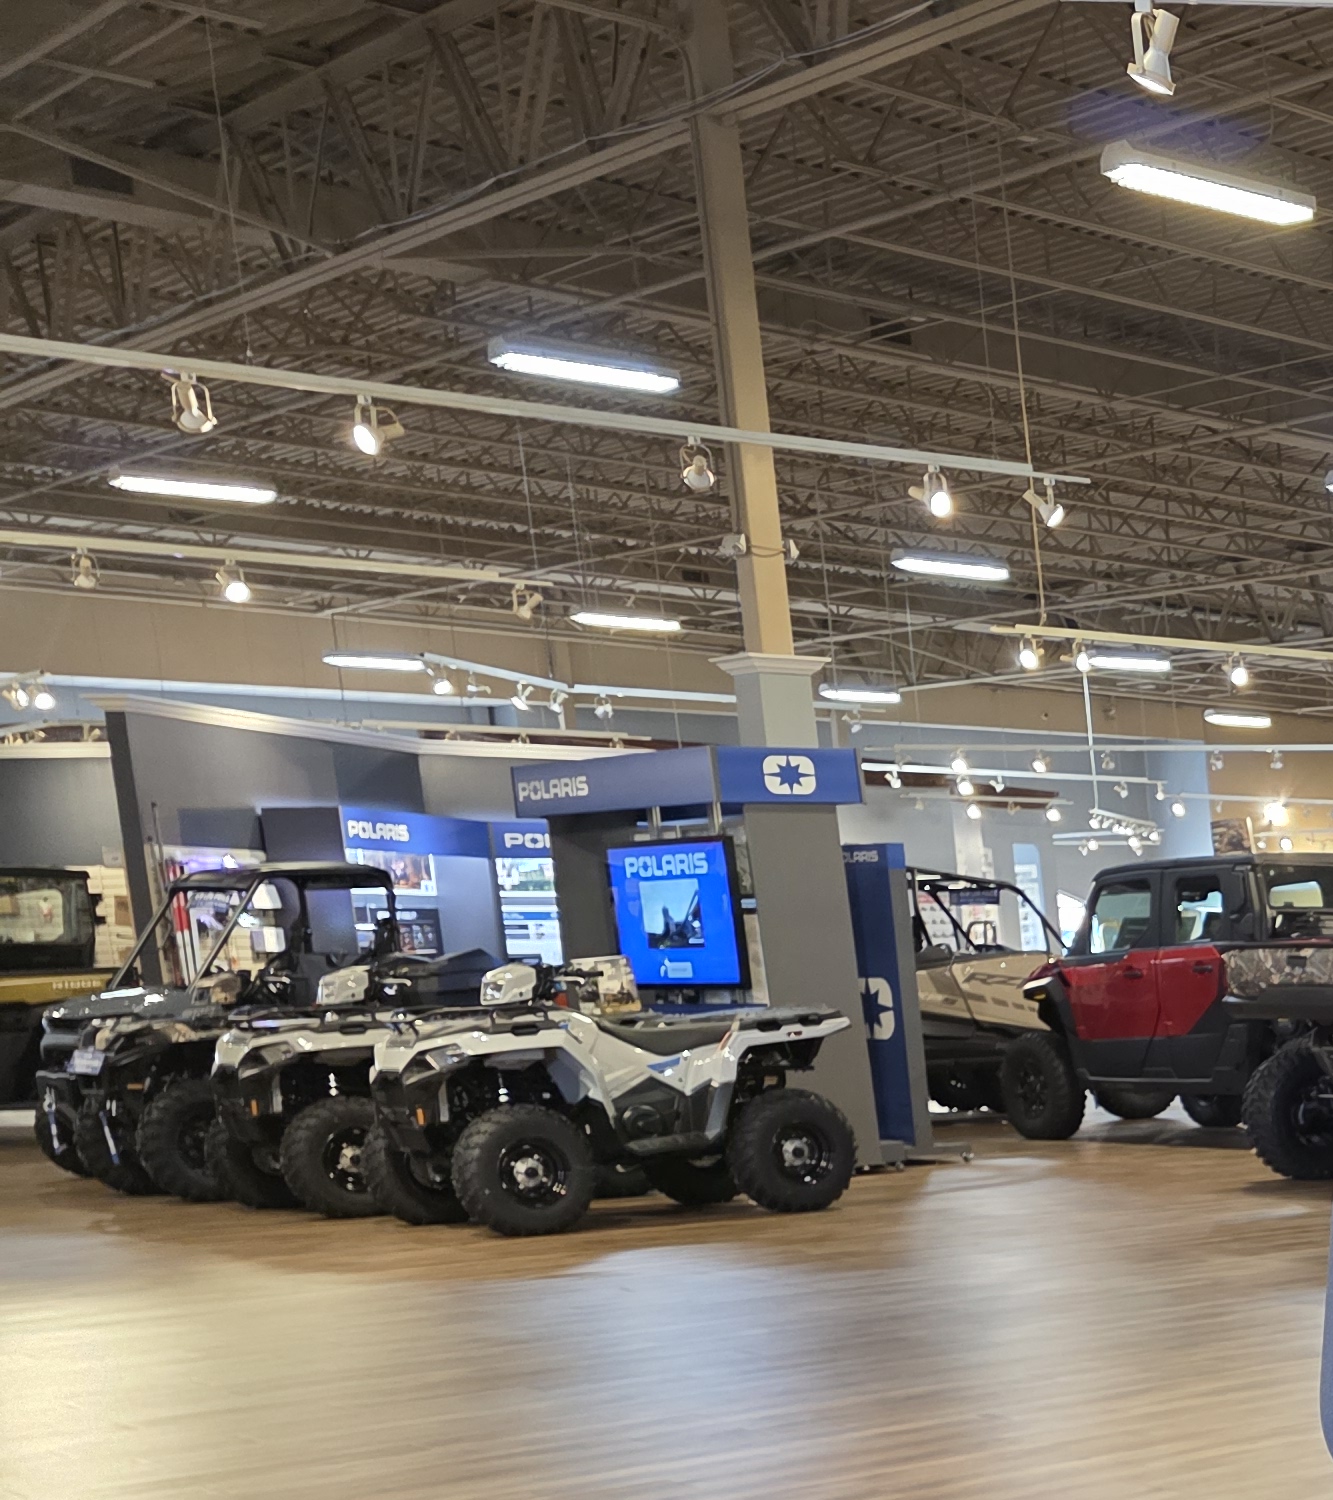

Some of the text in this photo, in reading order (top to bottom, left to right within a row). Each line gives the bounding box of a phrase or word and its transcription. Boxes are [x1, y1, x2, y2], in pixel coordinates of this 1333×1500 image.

[518, 776, 589, 802] POLARIS
[347, 820, 410, 842] POLARIS
[624, 852, 709, 878] POLARIS
